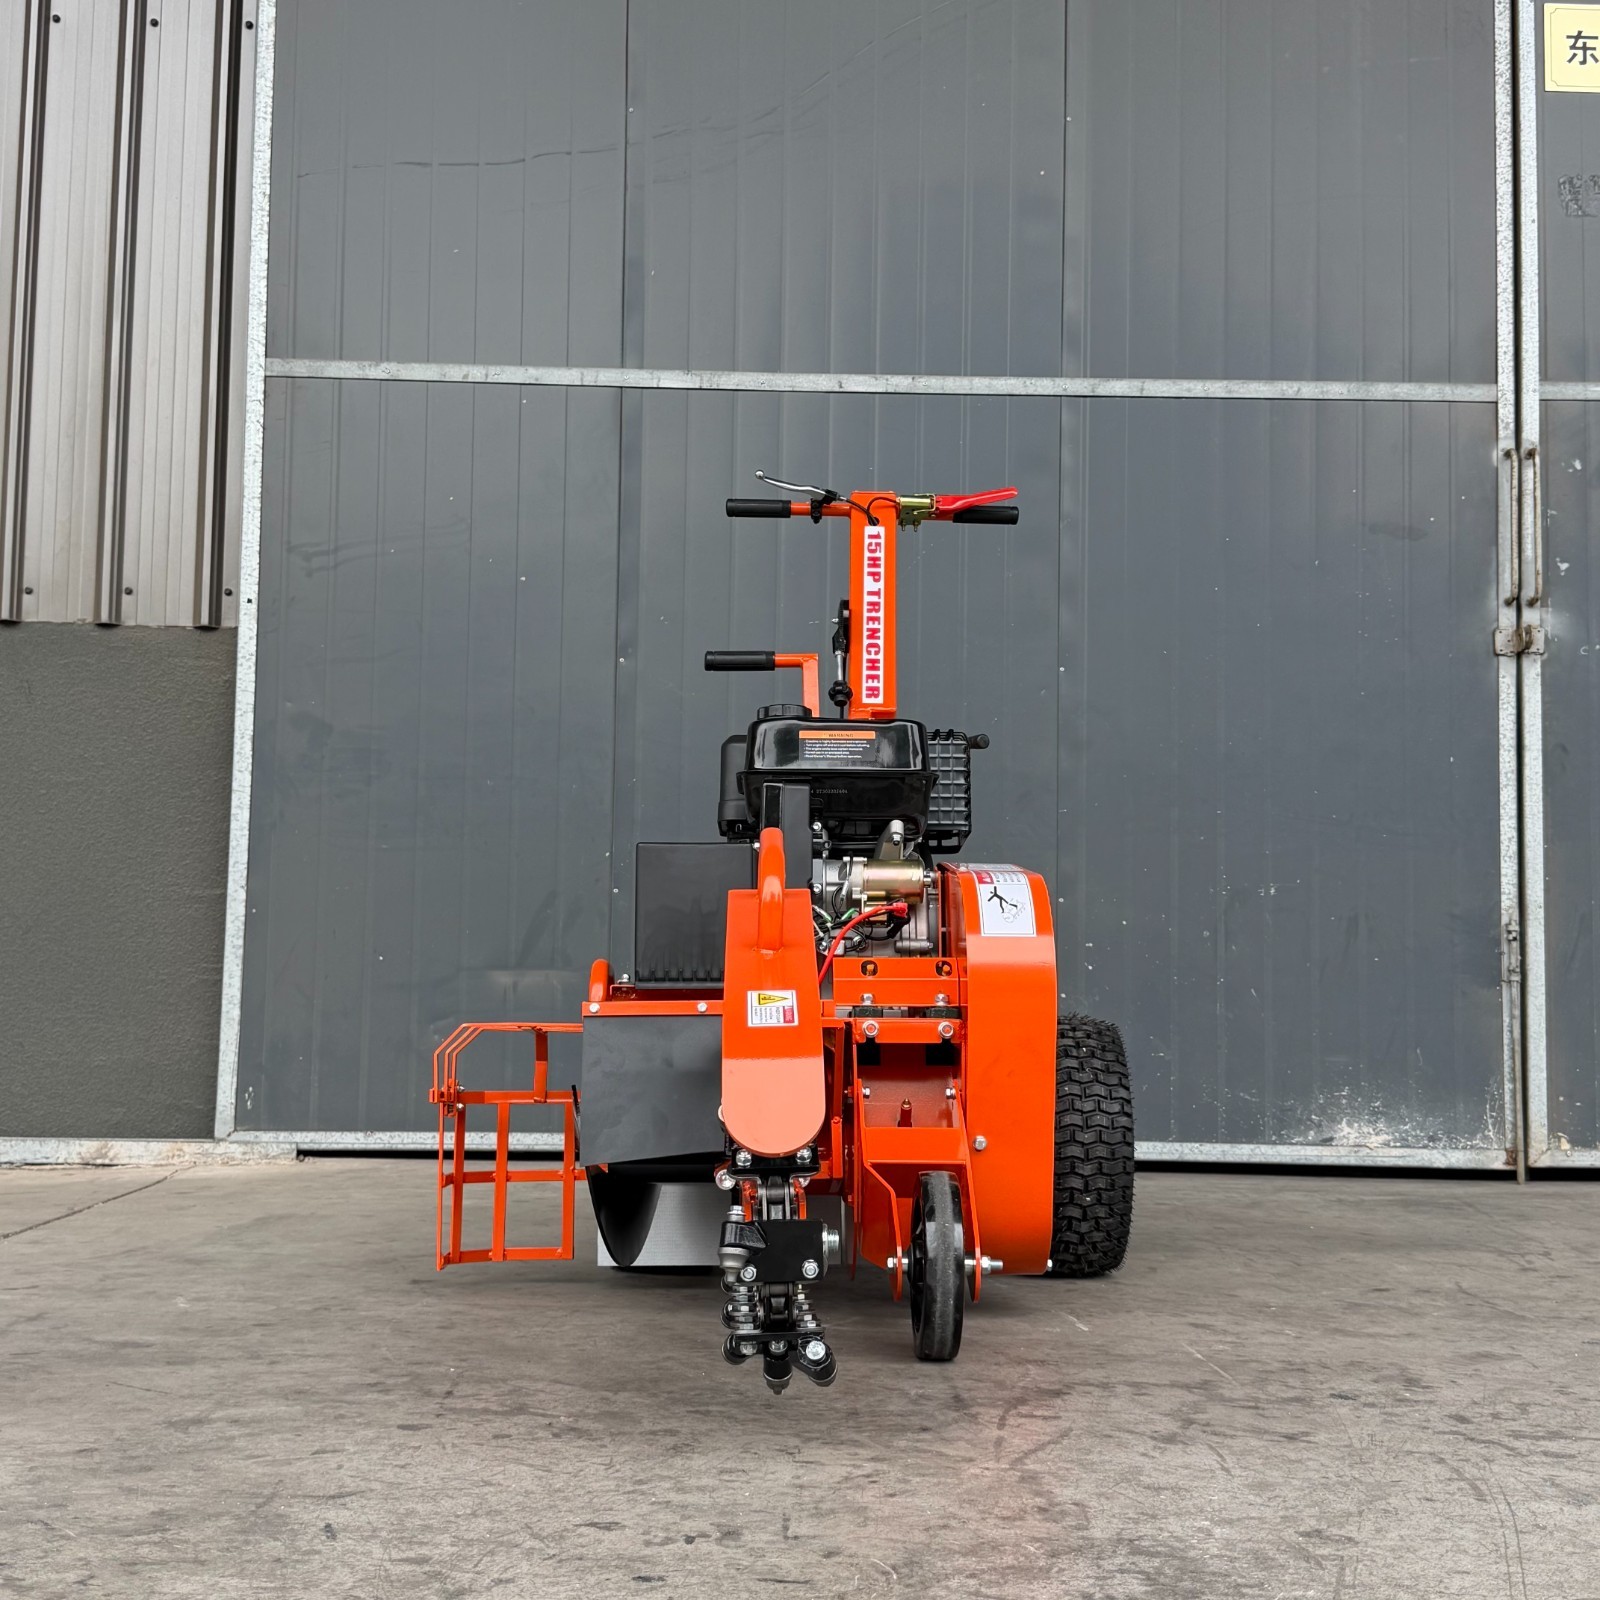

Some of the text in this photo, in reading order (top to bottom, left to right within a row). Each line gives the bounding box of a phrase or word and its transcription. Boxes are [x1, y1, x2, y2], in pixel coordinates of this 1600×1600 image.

[1566, 30, 1600, 66] 东
[866, 531, 882, 699] 15HP TRENCHER
